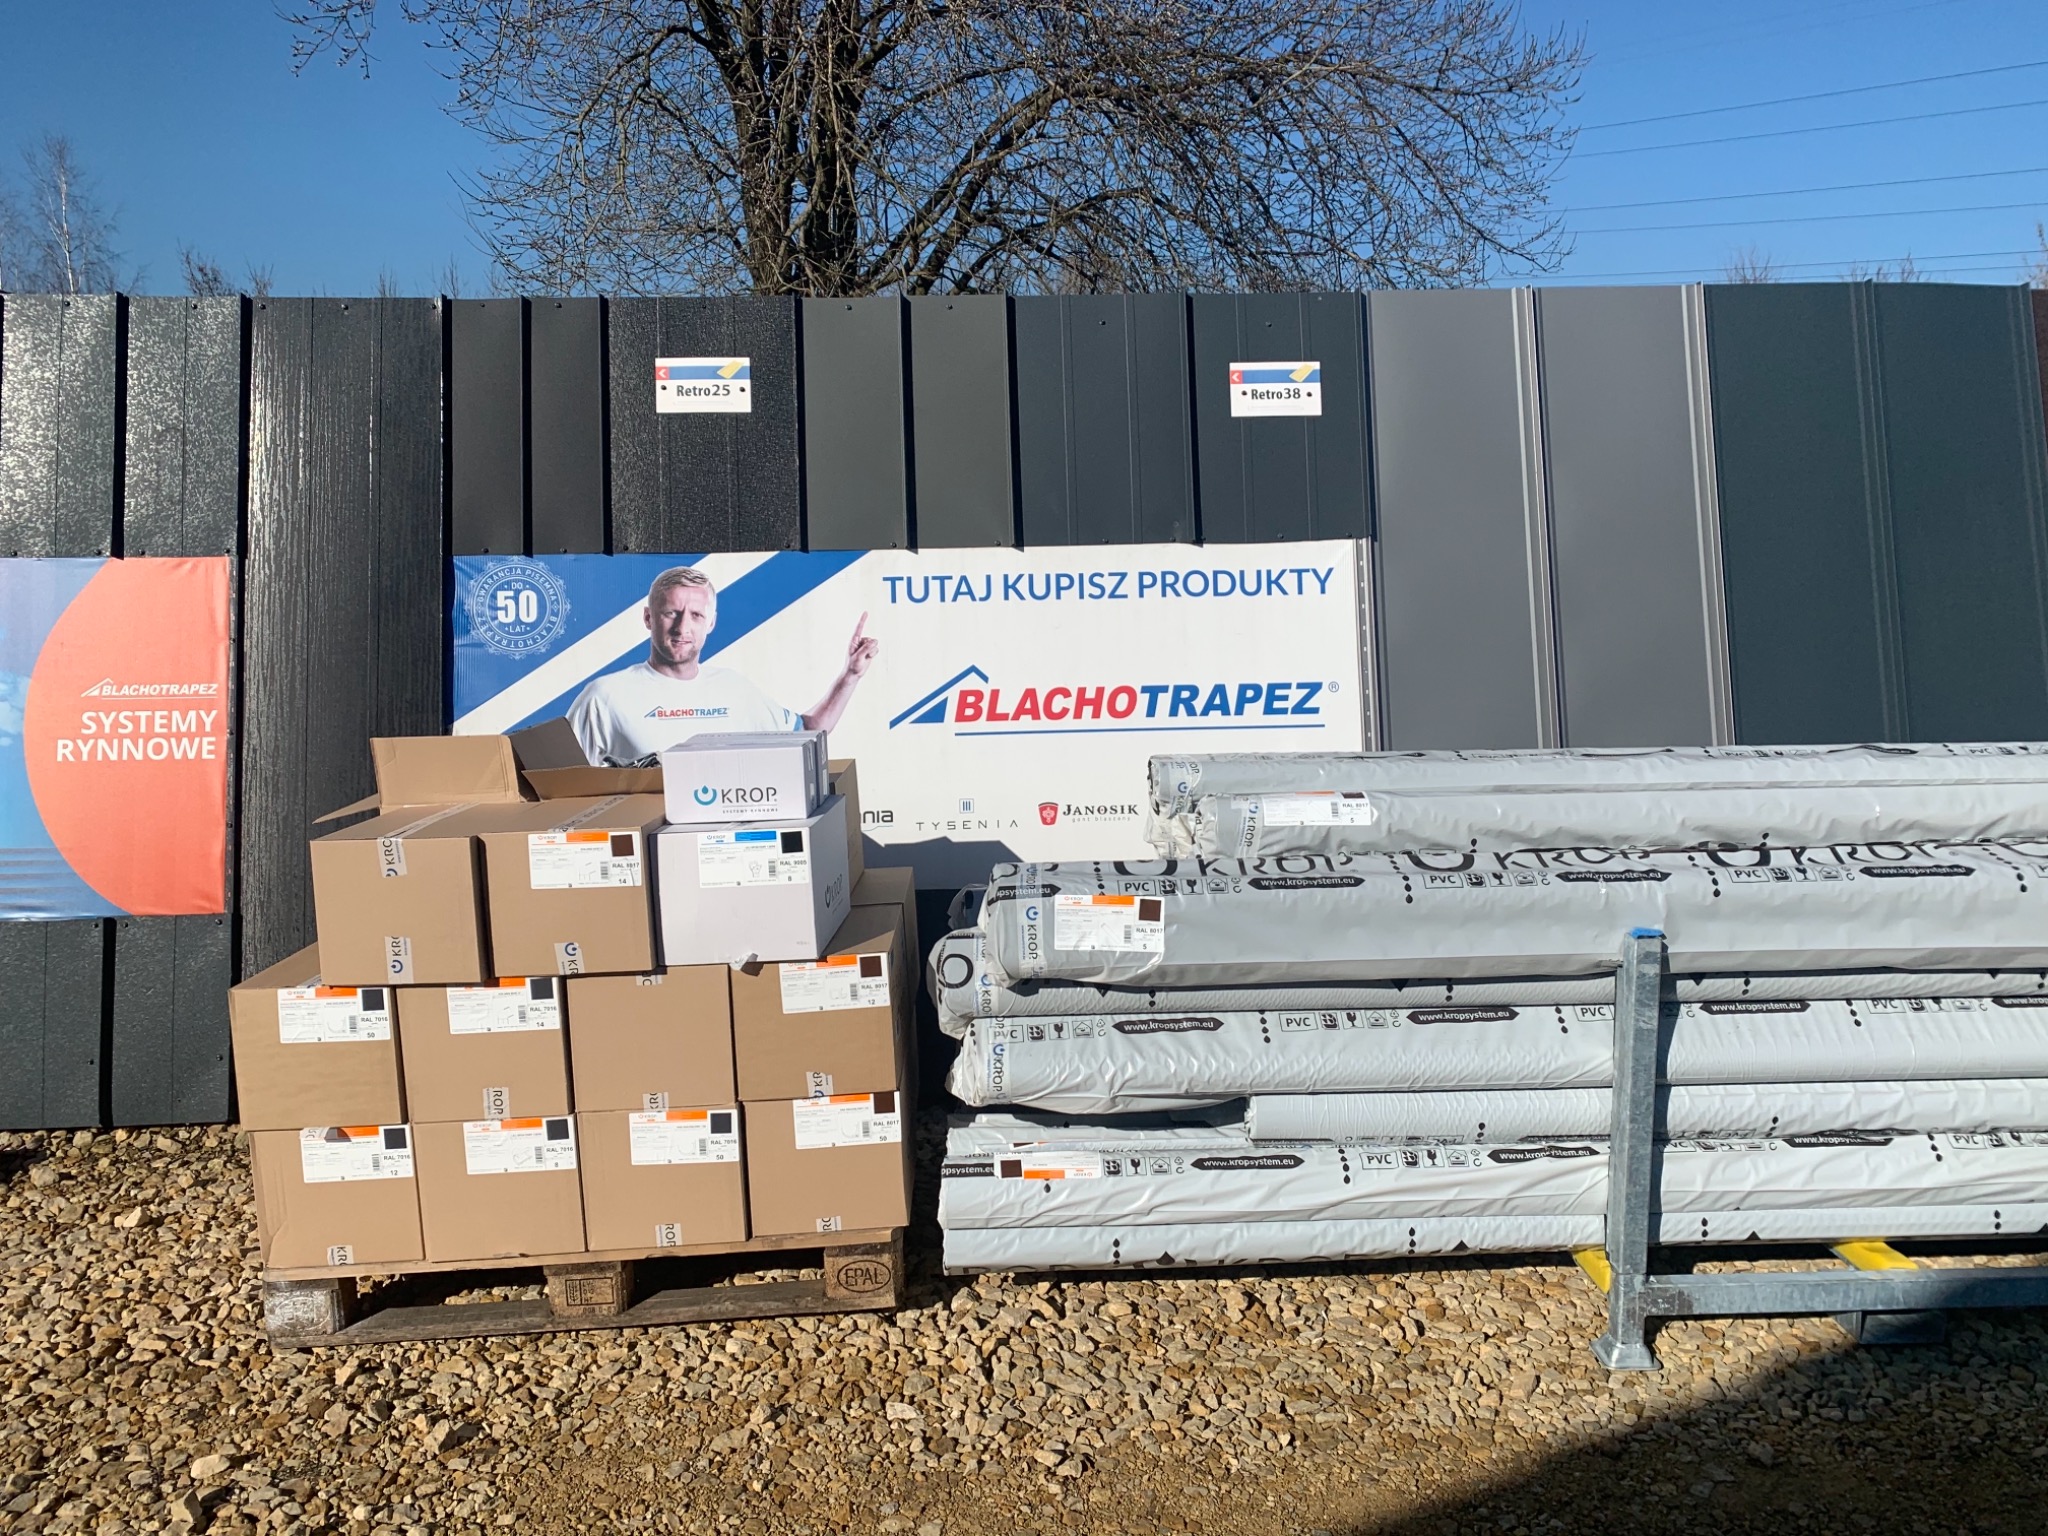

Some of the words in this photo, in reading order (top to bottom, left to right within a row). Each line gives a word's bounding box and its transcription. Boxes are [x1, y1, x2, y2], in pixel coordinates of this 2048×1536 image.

[676, 384, 731, 397] Retro25
[1251, 387, 1301, 400] Retro38
[478, 567, 522, 603] GWARANCJA
[525, 568, 558, 602] PISEMNA
[511, 582, 523, 590] DO
[883, 575, 993, 604] TUTAJ
[1003, 571, 1129, 601] KUPISZ
[1138, 567, 1335, 599] PRODUKTY
[496, 589, 538, 624] 50
[478, 615, 558, 648] BLACHOTRAPEZ
[509, 625, 526, 633] LAT
[102, 683, 219, 696] BLACHOTRAPEZ
[954, 681, 1324, 723] BLACHOTRAPEZ
[657, 707, 728, 719] BLACHOTRAPEZ
[80, 709, 218, 735] SYSTEMY
[56, 737, 217, 762] RYNNOWE
[720, 786, 777, 804] KROP
[916, 820, 1018, 831] TYSENIA
[1429, 874, 1457, 885] PVC
[1733, 869, 1763, 879] PVC
[1124, 882, 1150, 893] PVC
[1260, 876, 1355, 889] www.kropsystem.eu
[1027, 924, 1039, 960] KROP
[1711, 1001, 1801, 1012] www.kropsystem.eu
[1871, 998, 1899, 1010] PVC
[1417, 1010, 1510, 1022] www.kropsystem.eu
[1580, 1006, 1606, 1018] PVC
[1123, 1020, 1214, 1032] www.kropsystem.eu
[1285, 1017, 1312, 1028] PVC
[1954, 1135, 1979, 1145] PVC
[1203, 1157, 1295, 1169] www.kropsystem.eu
[1366, 1154, 1392, 1165] PVC
[844, 1267, 884, 1287] EPAL
